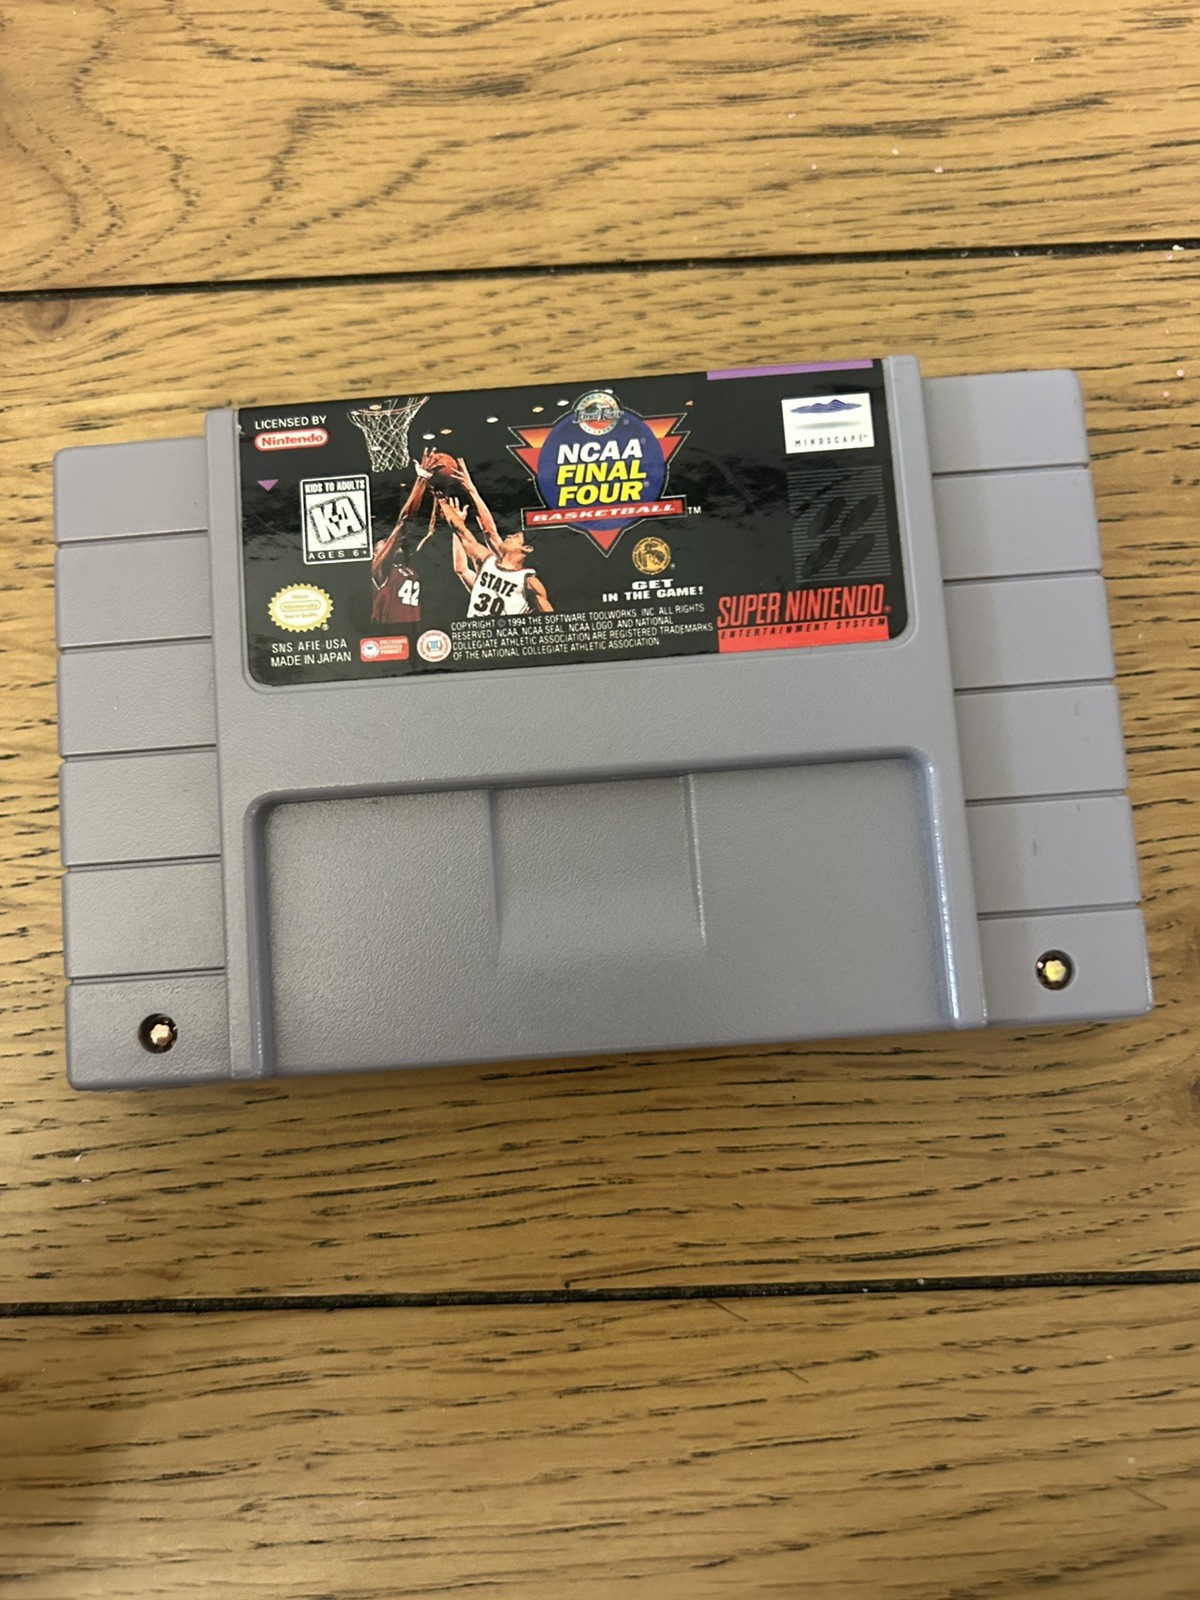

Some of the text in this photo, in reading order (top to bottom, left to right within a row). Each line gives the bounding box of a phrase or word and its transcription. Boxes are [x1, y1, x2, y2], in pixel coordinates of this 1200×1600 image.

[255, 415, 327, 430] LICENSED BY
[261, 432, 323, 446] Nintendo
[795, 434, 863, 447] MINDSCAPE
[557, 438, 643, 464] NCAA
[557, 460, 647, 485] FINAL
[305, 479, 366, 493] KIDS TO ADULTS
[558, 481, 643, 507] FOUR
[532, 504, 676, 522] BASKETBALL
[687, 506, 701, 515] TM
[308, 549, 368, 560] AGES 6+
[398, 579, 421, 607] 42
[480, 571, 517, 598] STATE
[602, 586, 704, 603] IN THE GAME!
[632, 579, 674, 590] GET
[474, 593, 505, 616] 30
[717, 583, 885, 628] SUPER NINTENDO
[451, 619, 495, 631] COPYRIGHT
[508, 617, 526, 627] 1994
[529, 616, 542, 625] THE
[545, 613, 586, 624] SOFTWARE
[659, 606, 673, 615] ALL
[675, 603, 705, 614] RIGHTS
[522, 626, 543, 636] NCAA
[568, 622, 590, 632] NCAA
[617, 619, 634, 628] AND
[635, 616, 674, 627] NATIONAL
[453, 622, 714, 651] COLLEGIATE ATHLETIC ASSOCIATION ARE REGISTERED TRADEMARKS
[721, 616, 886, 640] ENTERTAINMENT SYSTEM
[271, 651, 351, 667] MADE IN JAPAN
[453, 637, 660, 660] OF THE NATIONAL COLLEGIATE ATHLETIC ASSOCIATION
